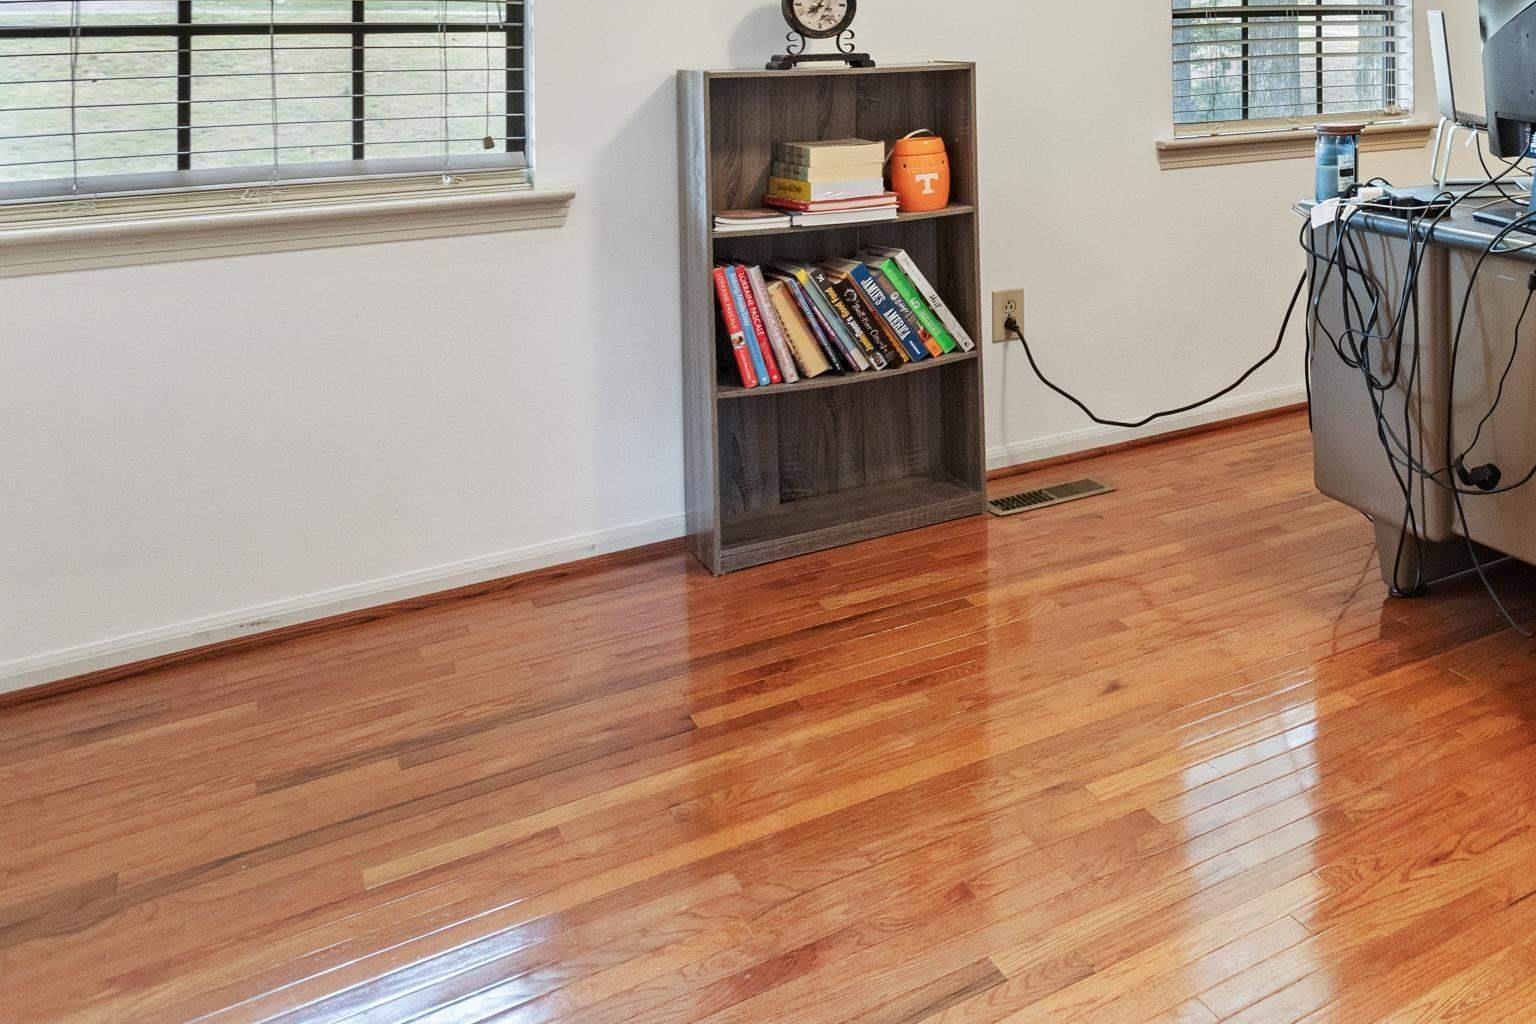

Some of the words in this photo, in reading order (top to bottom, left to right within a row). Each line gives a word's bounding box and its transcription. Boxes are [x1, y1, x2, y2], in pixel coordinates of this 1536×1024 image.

[914, 172, 940, 195] T
[715, 272, 730, 303] LORRAINE
[724, 302, 738, 329] PASCALE
[737, 271, 755, 306] LORRAINE
[749, 306, 765, 336] PASCALE
[824, 285, 839, 303] Food
[834, 300, 850, 318] Good
[859, 275, 886, 306] JAMIE'S
[882, 307, 912, 340] AMERICA
